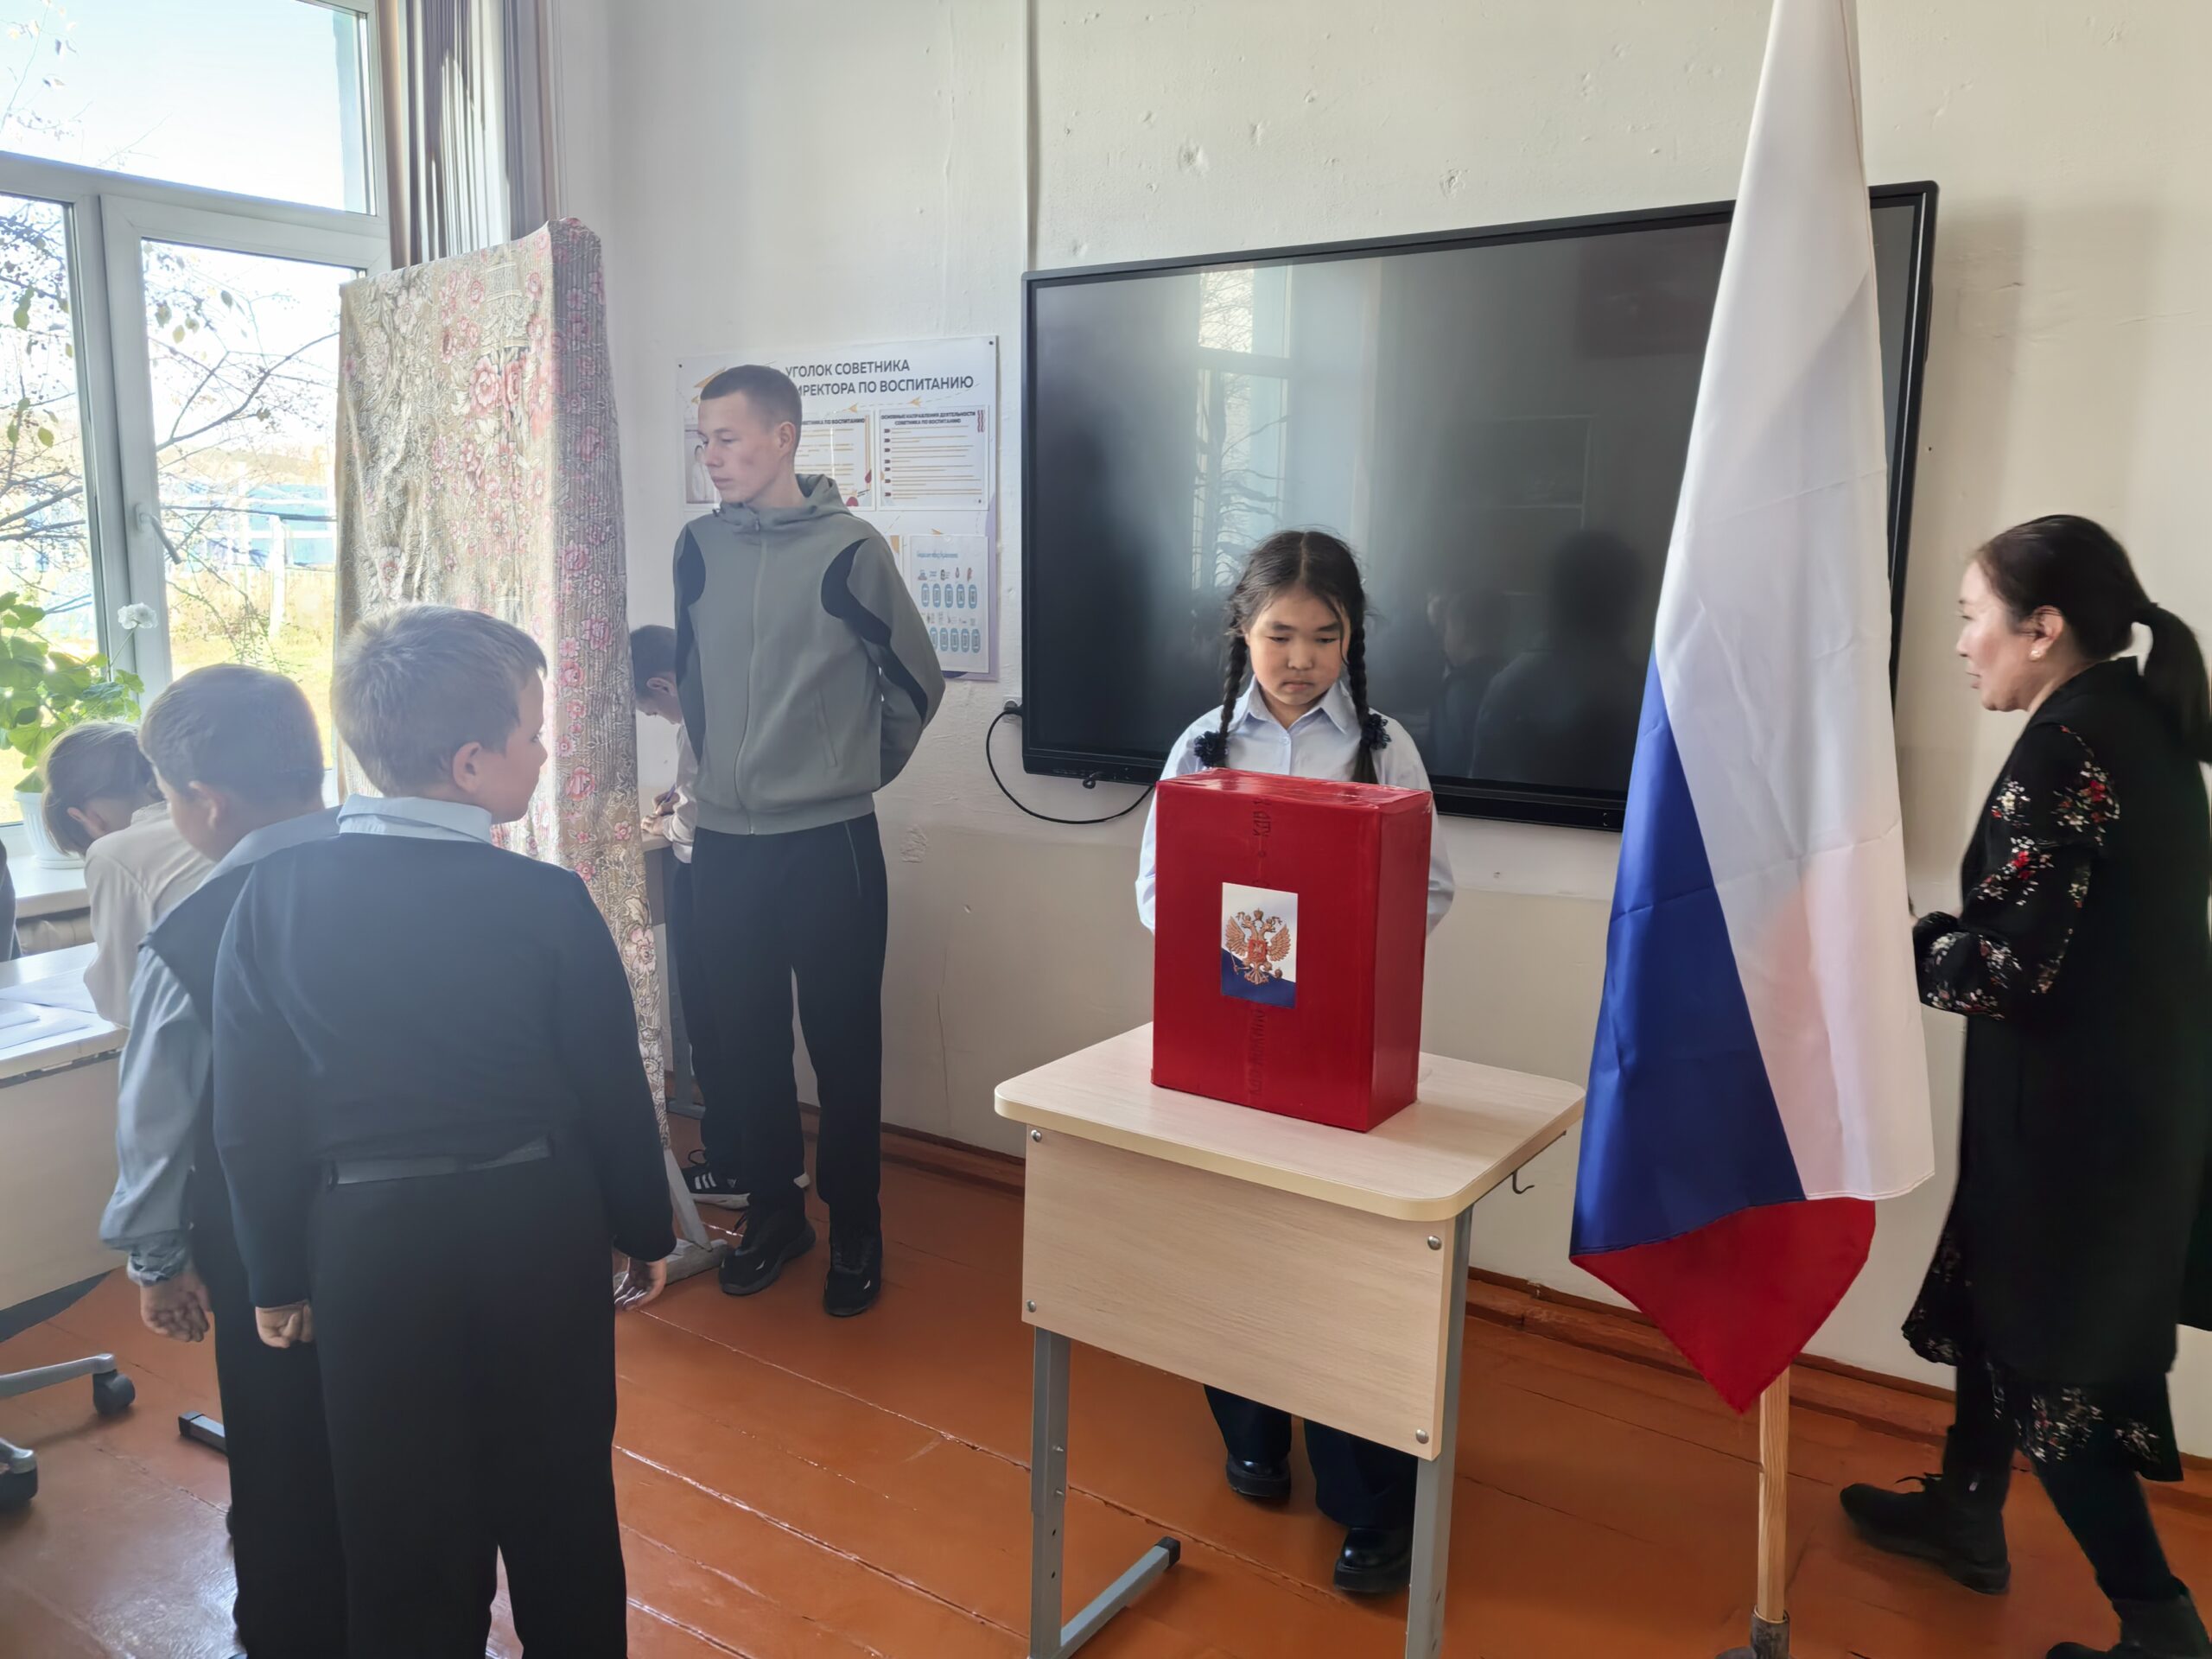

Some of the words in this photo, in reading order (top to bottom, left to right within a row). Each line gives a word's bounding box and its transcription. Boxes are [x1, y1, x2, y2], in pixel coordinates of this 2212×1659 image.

[785, 363, 832, 378] УГОЛОК
[835, 359, 910, 375] СОВЕТНИКА
[797, 382, 856, 397] ИРЕКТОРА
[859, 381, 877, 393] ПО
[880, 375, 974, 392] ВОСПИТАНИЮ
